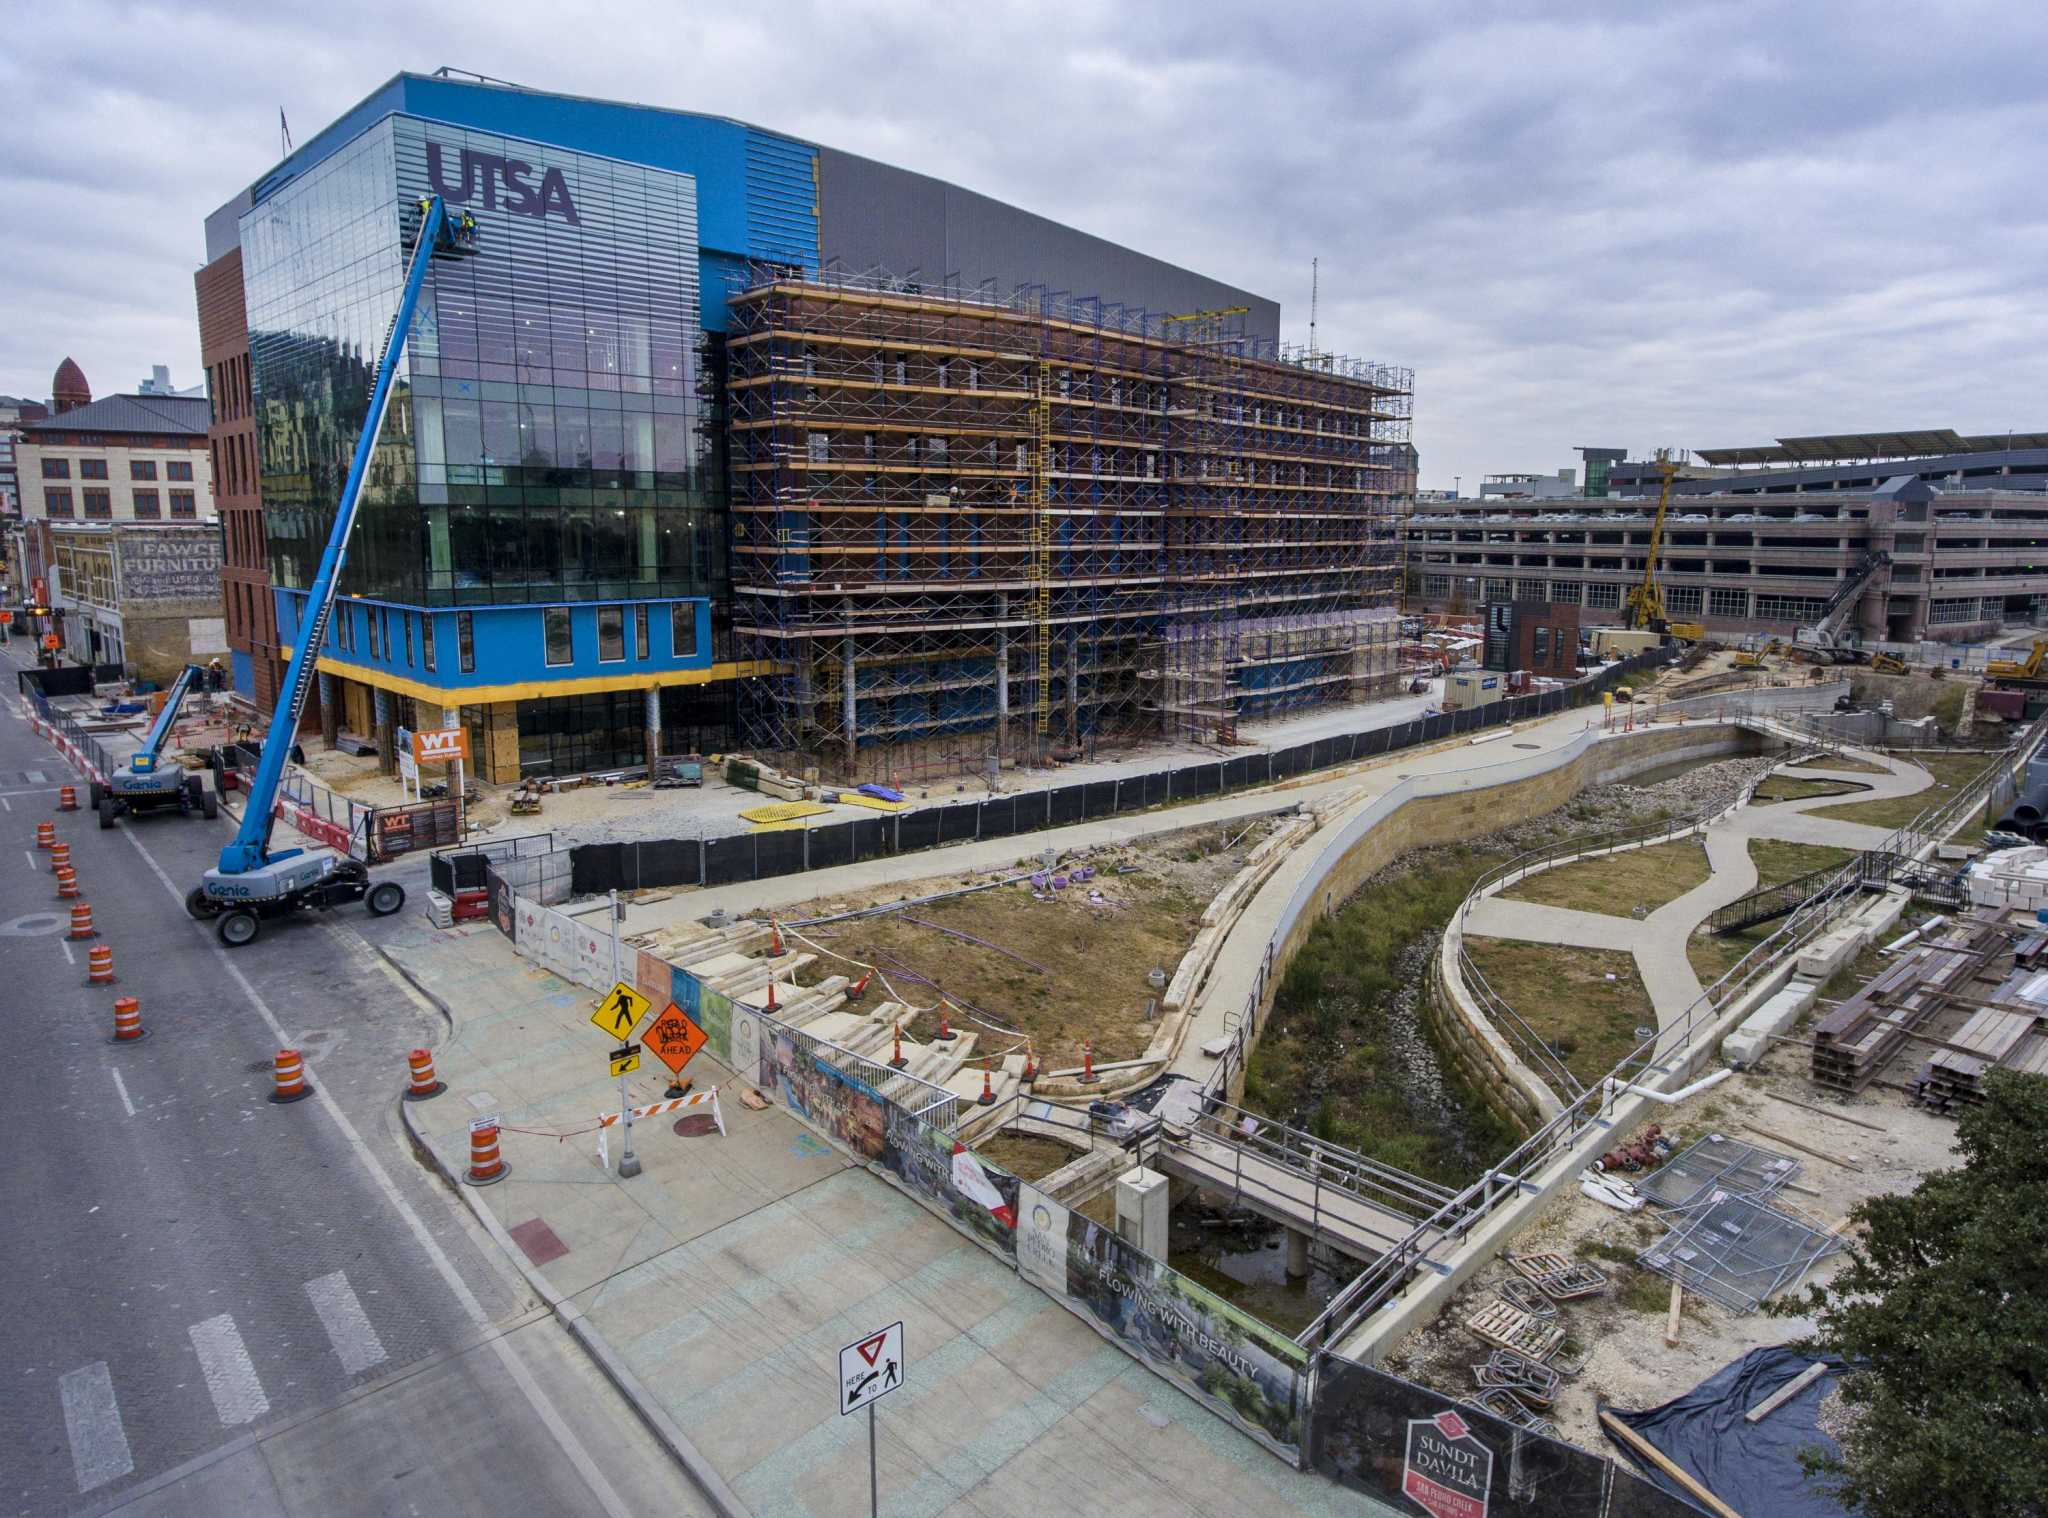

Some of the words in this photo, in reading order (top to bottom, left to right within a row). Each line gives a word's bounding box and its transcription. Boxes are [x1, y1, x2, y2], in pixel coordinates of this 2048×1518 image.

[426, 142, 582, 227] UTSA
[420, 730, 461, 749] WT
[122, 780, 162, 790] Genie
[384, 815, 410, 828] WT
[208, 882, 251, 896] Genie
[660, 1045, 691, 1054] AHEAD
[1100, 1270, 1156, 1314] FLOWING
[1160, 1306, 1200, 1343] WITH
[1199, 1333, 1259, 1379] BEAUTY
[846, 1371, 865, 1387] HERE
[868, 1384, 877, 1394] TO
[1420, 1435, 1479, 1468] SUNDT
[1416, 1451, 1478, 1489] DAVILA
